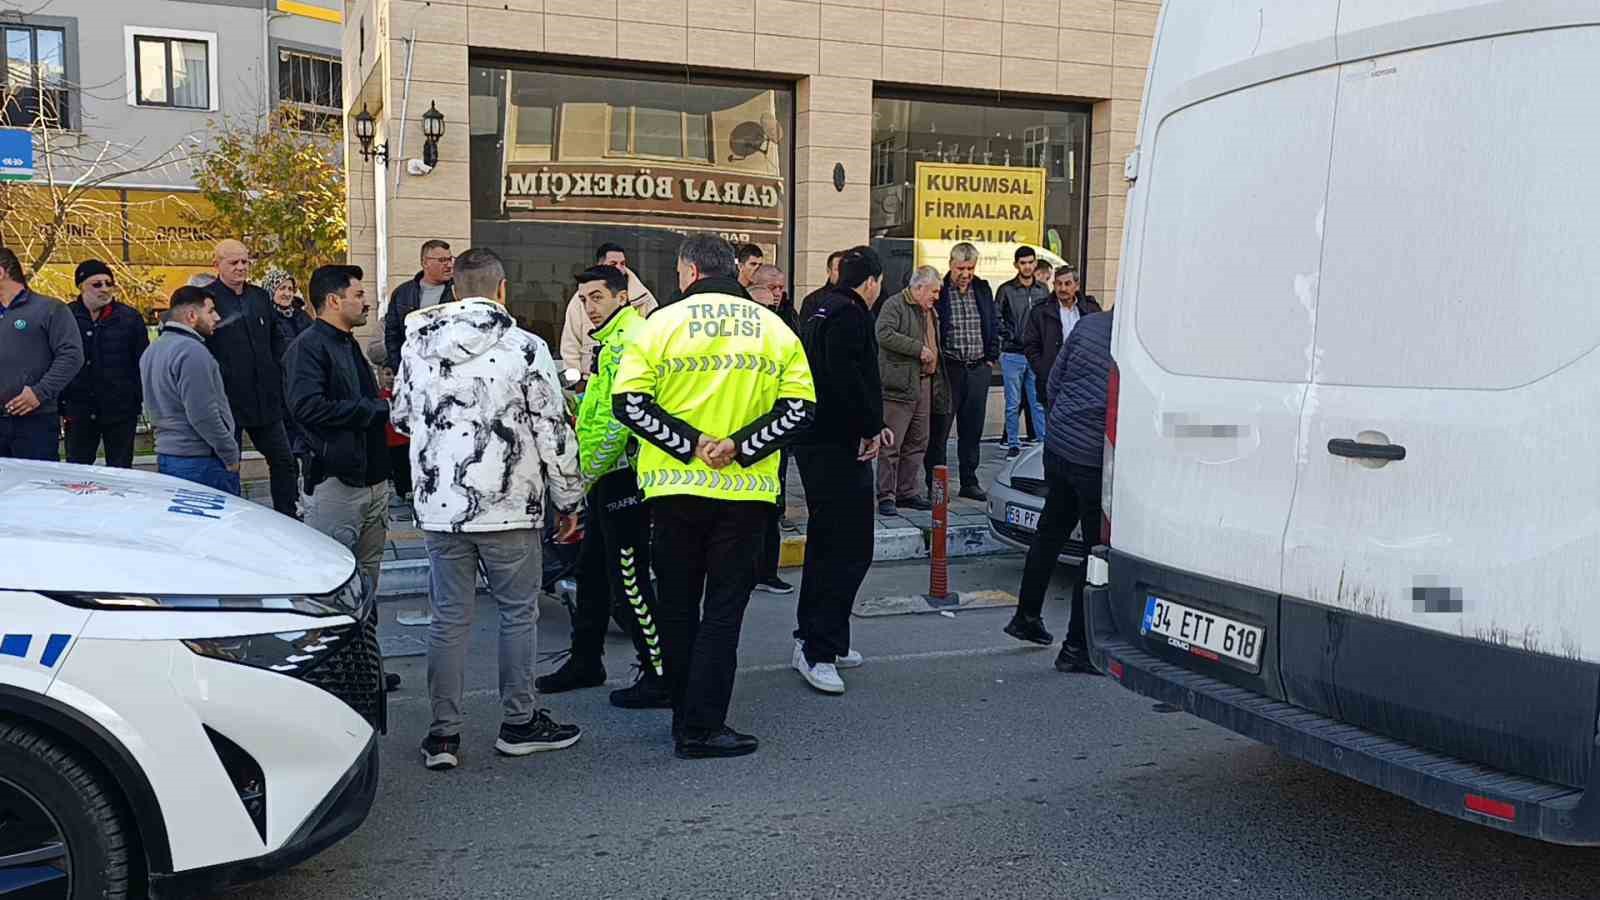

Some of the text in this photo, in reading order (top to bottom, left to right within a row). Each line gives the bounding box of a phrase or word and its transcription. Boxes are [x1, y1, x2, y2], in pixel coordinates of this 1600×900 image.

[927, 174, 1033, 195] KURUMSAL
[925, 198, 1034, 221] FİRMALARA
[1152, 602, 1171, 632] 34
[1180, 610, 1215, 645] ETT
[1223, 623, 1257, 658] 618
